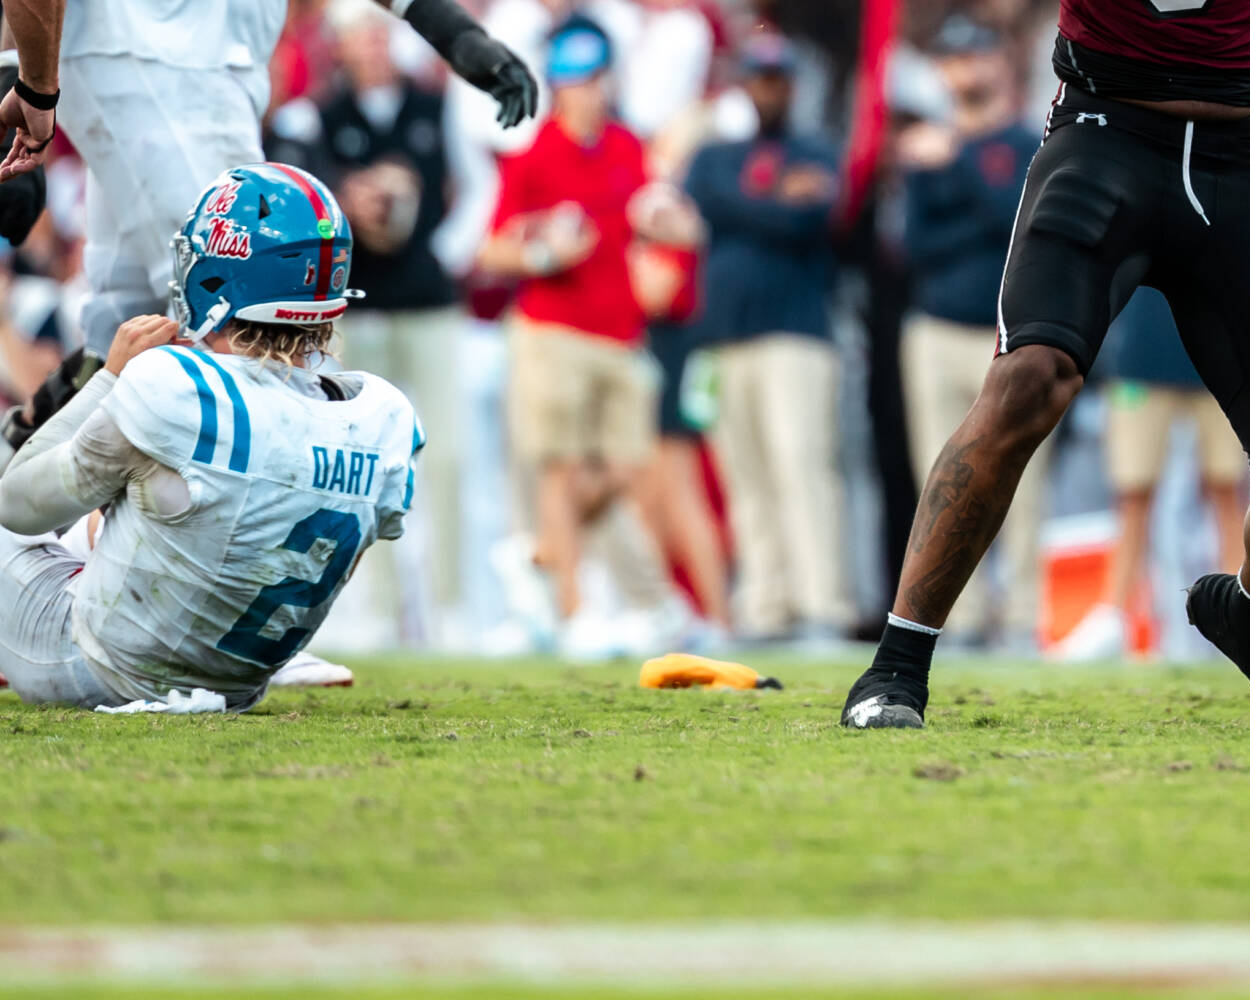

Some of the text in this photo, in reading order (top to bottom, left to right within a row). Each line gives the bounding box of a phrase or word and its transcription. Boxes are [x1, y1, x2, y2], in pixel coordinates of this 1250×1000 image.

[206, 182, 240, 214] Ole
[206, 218, 251, 259] Miss
[312, 445, 380, 497] DART
[215, 507, 362, 666] 2
